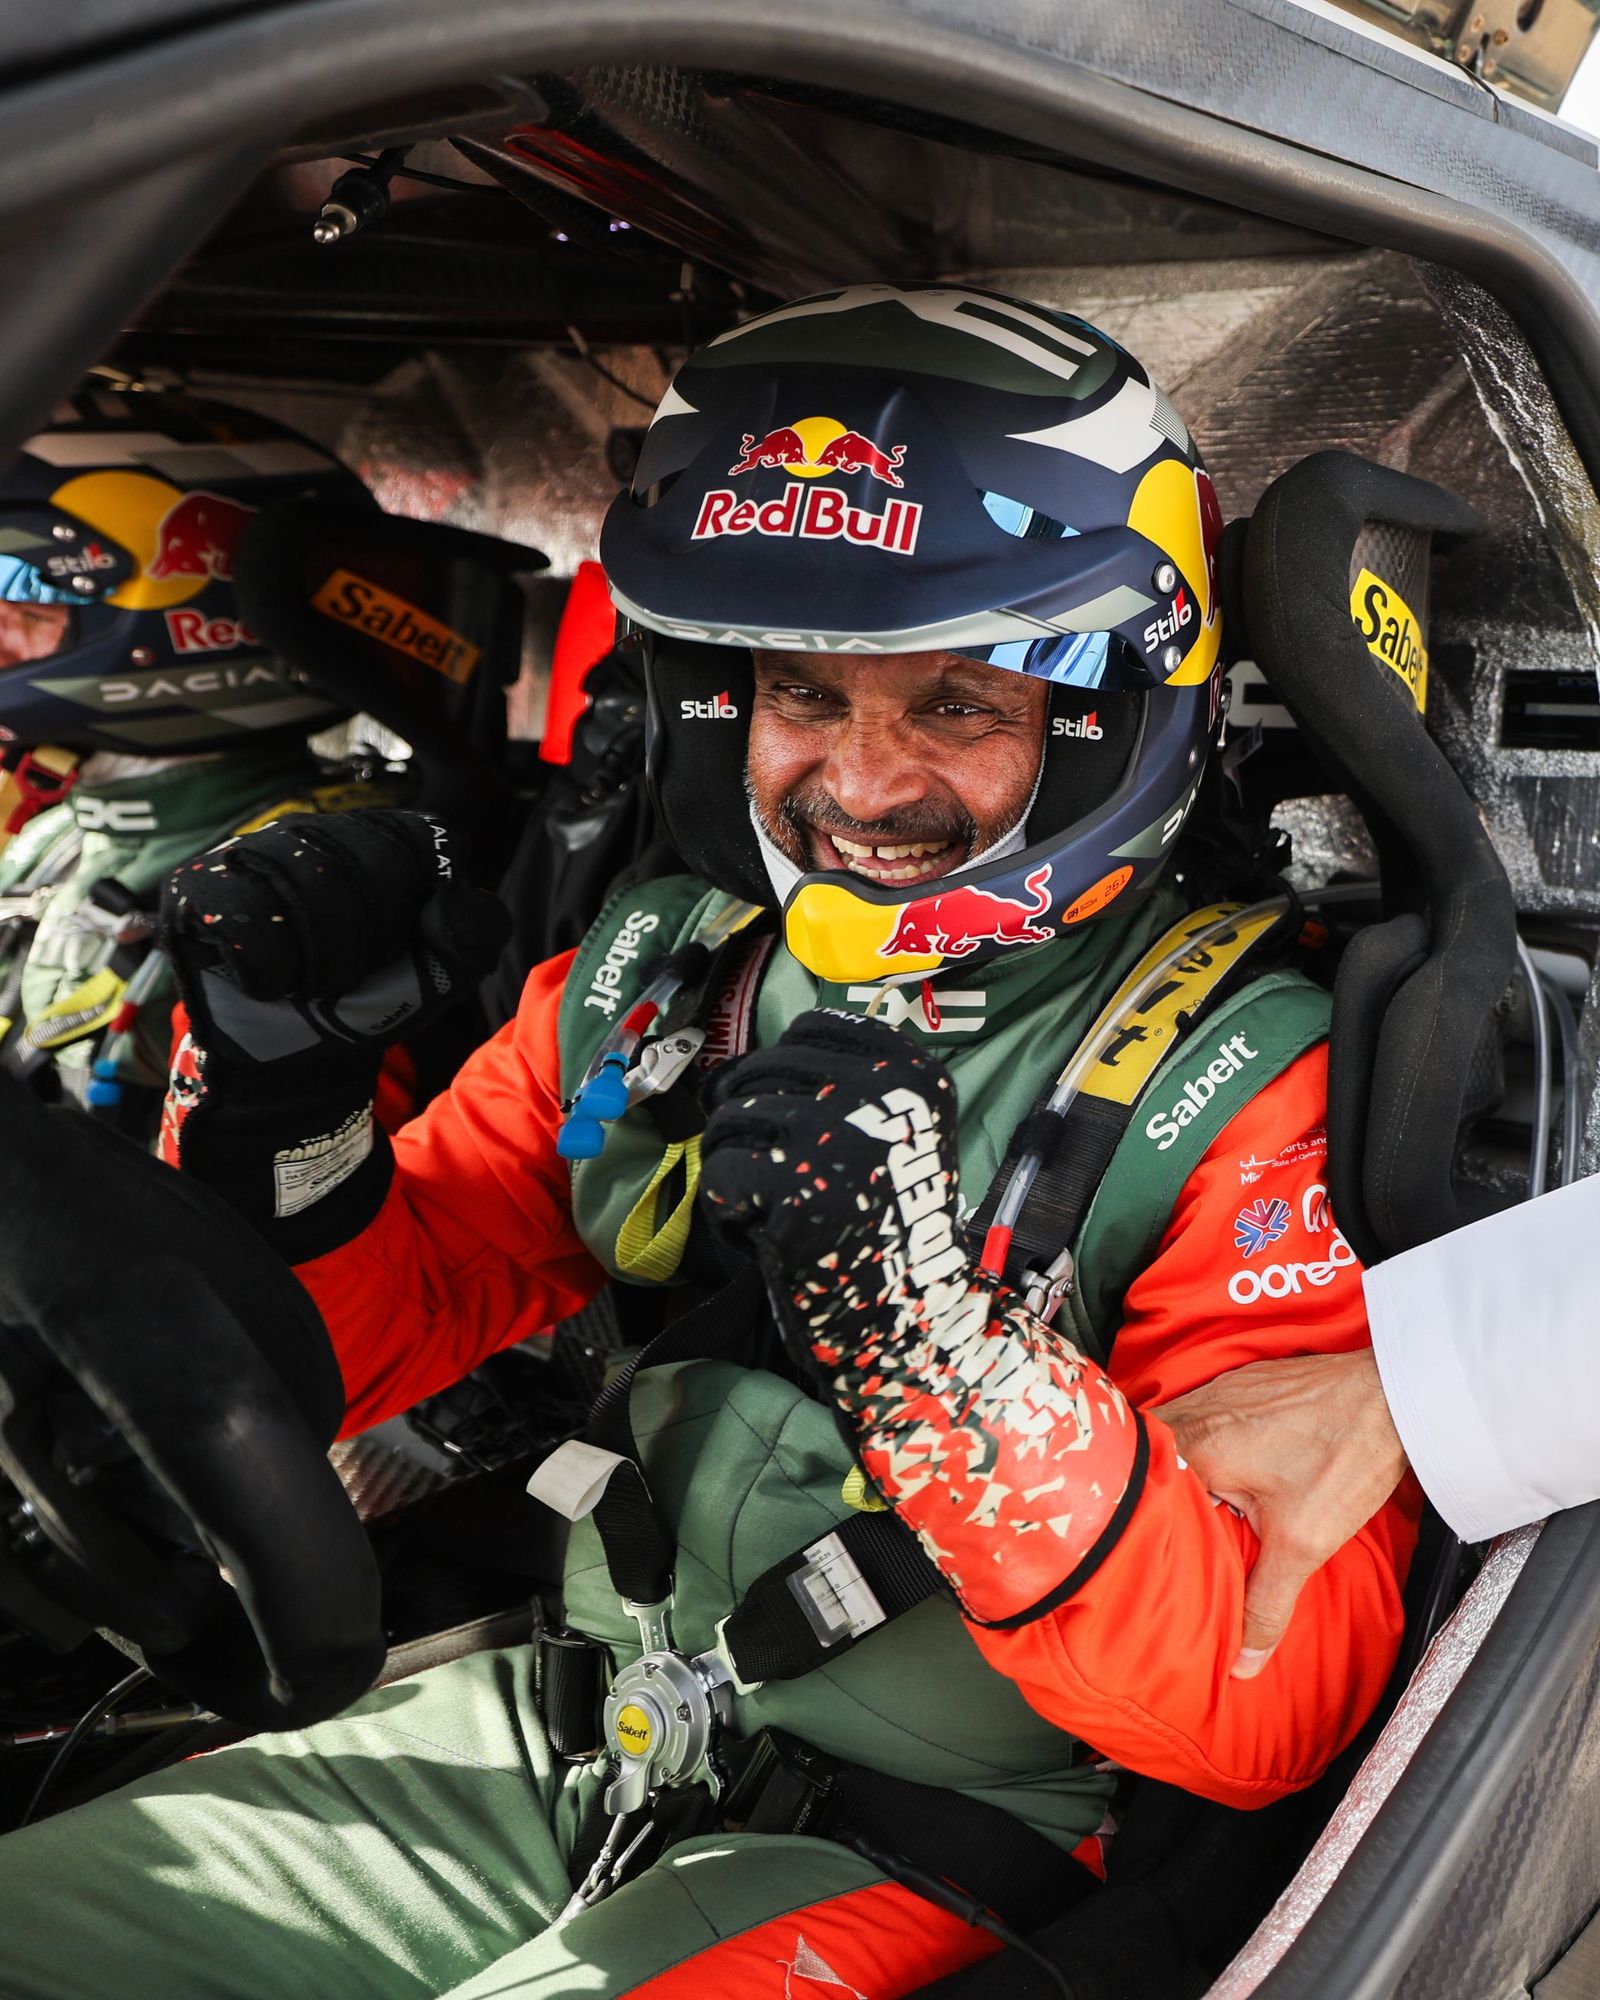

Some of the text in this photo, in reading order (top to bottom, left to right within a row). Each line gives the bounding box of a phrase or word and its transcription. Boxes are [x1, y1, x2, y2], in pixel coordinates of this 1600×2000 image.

[690, 482, 922, 556] Red Bull
[46, 546, 116, 577] Stilo
[329, 582, 466, 673] Sabelt
[666, 622, 884, 650] DACIA
[1143, 598, 1193, 654] Stilo
[99, 665, 277, 703] DACIA
[680, 694, 738, 720] Stilo
[1051, 714, 1104, 741] Stilo
[429, 824, 452, 880] AL AT
[1104, 874, 1126, 897] 261
[584, 910, 659, 1015] Sabelt
[1146, 1032, 1259, 1151] Sabelt
[617, 1720, 649, 1741] Sabelt
